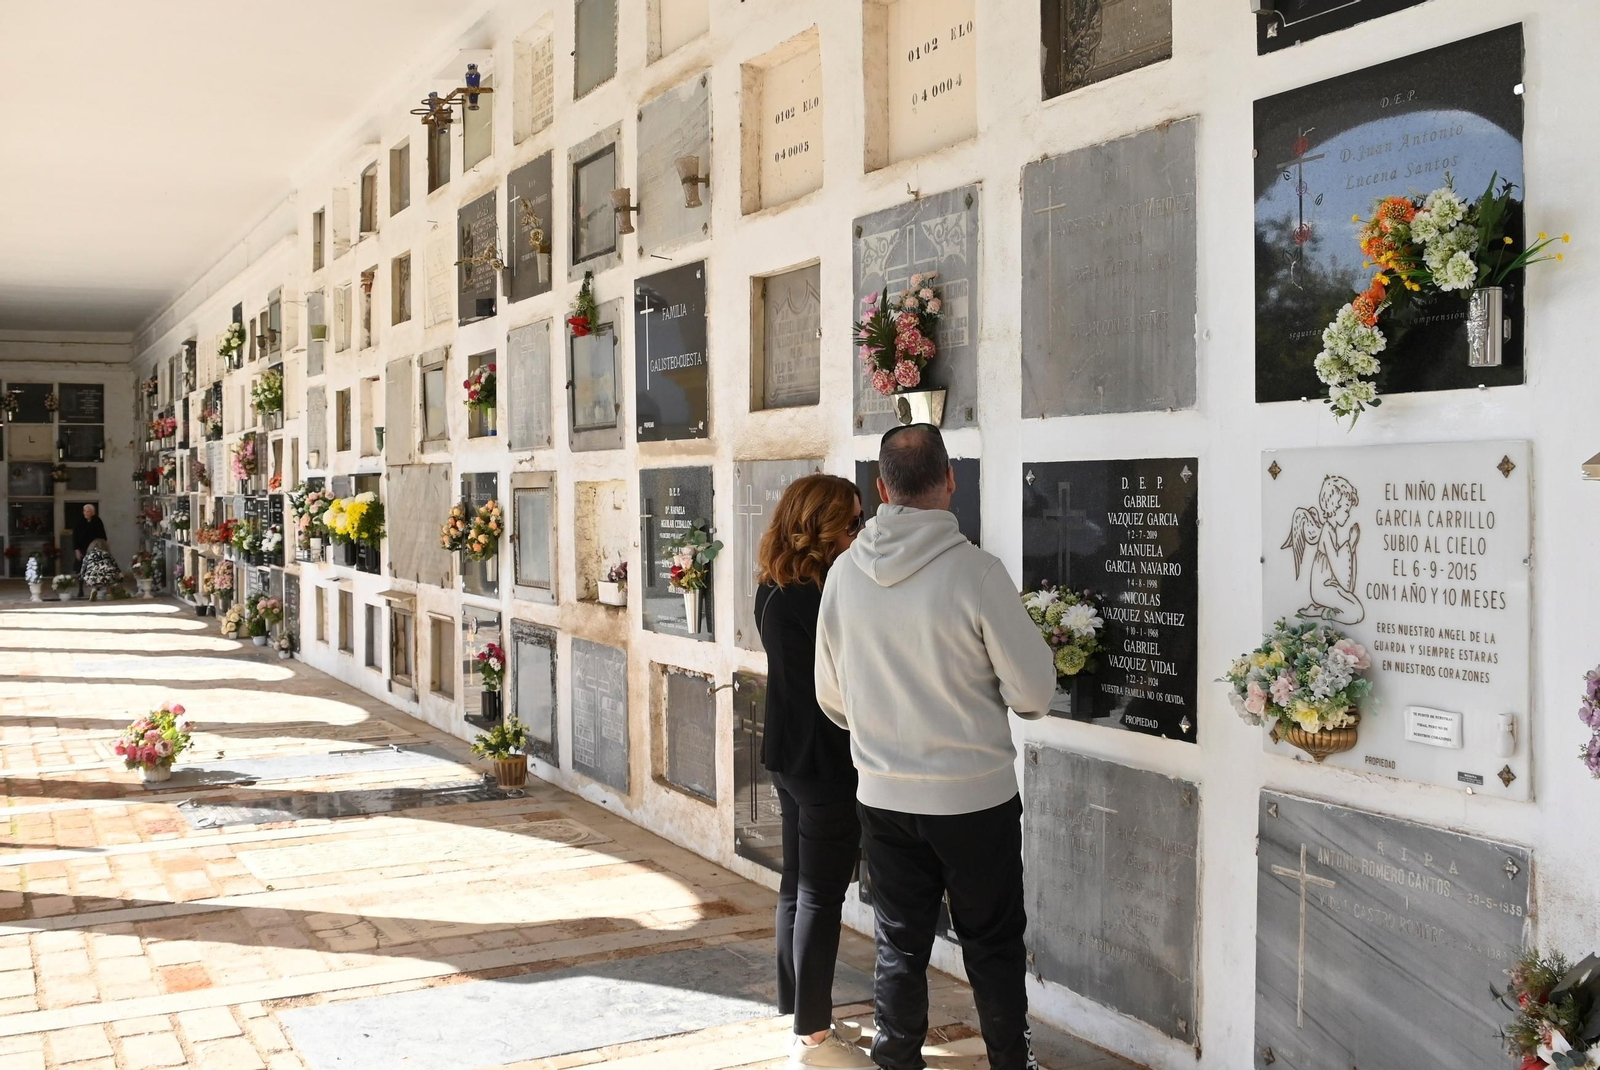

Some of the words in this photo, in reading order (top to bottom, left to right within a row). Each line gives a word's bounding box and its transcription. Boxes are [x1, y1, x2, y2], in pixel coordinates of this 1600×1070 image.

[908, 38, 939, 63] 0102
[950, 21, 973, 41] ELO
[775, 107, 795, 124] 0102
[803, 97, 819, 113] ELO
[1401, 123, 1464, 149] Antonio
[774, 141, 810, 162] 040005
[1344, 168, 1398, 190] Lucena
[1406, 154, 1459, 177] Santos
[662, 303, 686, 320] FAMILIA
[650, 352, 702, 372] GALISTEO-CUESTA
[1385, 483, 1398, 501] EL
[1405, 480, 1436, 501] NIÑO
[1442, 483, 1486, 502] ANGEL
[1124, 495, 1160, 508] GABRIEL
[1108, 513, 1144, 526] VAZQUEZ
[1147, 514, 1178, 526] GARCIA
[1376, 510, 1422, 528] GARCIA
[1427, 510, 1496, 530] CARRILLO
[1120, 544, 1163, 557] MANUELA
[1383, 535, 1418, 553] SUBIO
[1424, 536, 1441, 554] AL
[1447, 537, 1486, 555] CIELO
[1105, 560, 1138, 574] GARCIA
[1140, 562, 1181, 576] NAVARRO
[1393, 561, 1407, 577] EL
[1124, 592, 1160, 606] NICOLAS
[1400, 583, 1427, 604] AÑO
[1431, 587, 1439, 604] Y
[1443, 588, 1457, 606] 10
[1460, 590, 1506, 610] MESES
[1102, 607, 1140, 622] VAZQUEZ
[1144, 611, 1184, 627] SANCHEZ
[1376, 622, 1396, 635] ERES
[1398, 624, 1436, 638] NUESTRO
[1438, 626, 1468, 642] ANGEL
[1470, 629, 1481, 643] DE
[1484, 631, 1496, 644] LA
[1124, 640, 1160, 656] GABRIEL
[1374, 640, 1406, 654] GUARDA
[1410, 644, 1415, 655] Y
[1418, 644, 1456, 660] SIEMPRE
[1459, 648, 1498, 664] ESTARAS
[1108, 654, 1146, 672] VAZQUEZ
[1151, 659, 1177, 676] VIDAL
[1382, 660, 1392, 671] EN
[1394, 661, 1436, 677] NUESTROS
[1438, 665, 1490, 684] CORAZONES
[1101, 684, 1122, 696] VUESTRA
[1124, 687, 1145, 699] FAMILIA
[1147, 690, 1154, 700] NO
[1156, 692, 1163, 701] OS
[1125, 715, 1158, 729] PROPIEDAD
[1365, 756, 1396, 770] PROPIEDAD
[1318, 847, 1359, 873] ANTONIO
[1362, 858, 1404, 885] ROMERO
[1354, 904, 1395, 929] CASTRO
